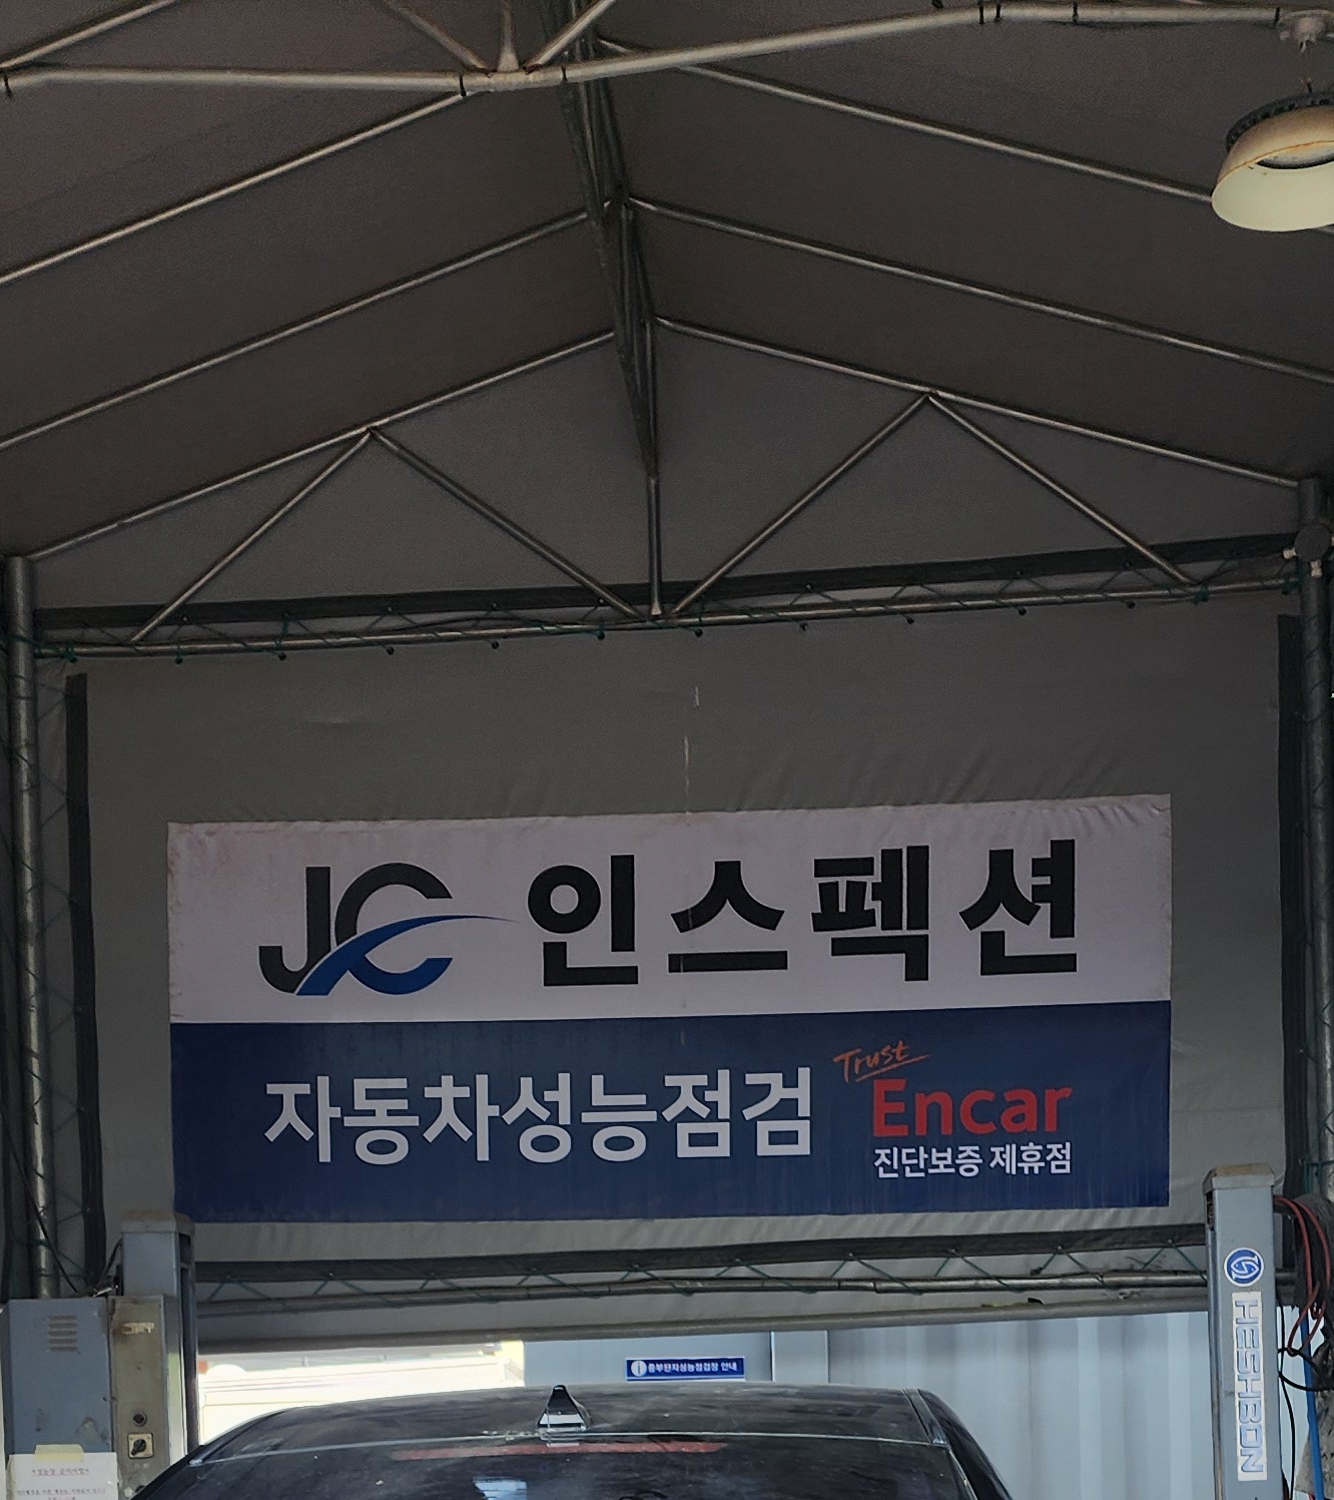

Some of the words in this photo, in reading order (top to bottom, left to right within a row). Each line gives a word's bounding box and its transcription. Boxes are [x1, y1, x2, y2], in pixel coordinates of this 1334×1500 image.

[527, 838, 1079, 987] 인스펙션
[833, 1040, 917, 1080] Trust
[264, 1064, 813, 1167] 자동차성능점검
[872, 1077, 1074, 1138] Encar
[873, 1146, 984, 1179] 진단보증
[989, 1142, 1072, 1175] 제휴점
[1235, 1300, 1264, 1473] HESHBON
